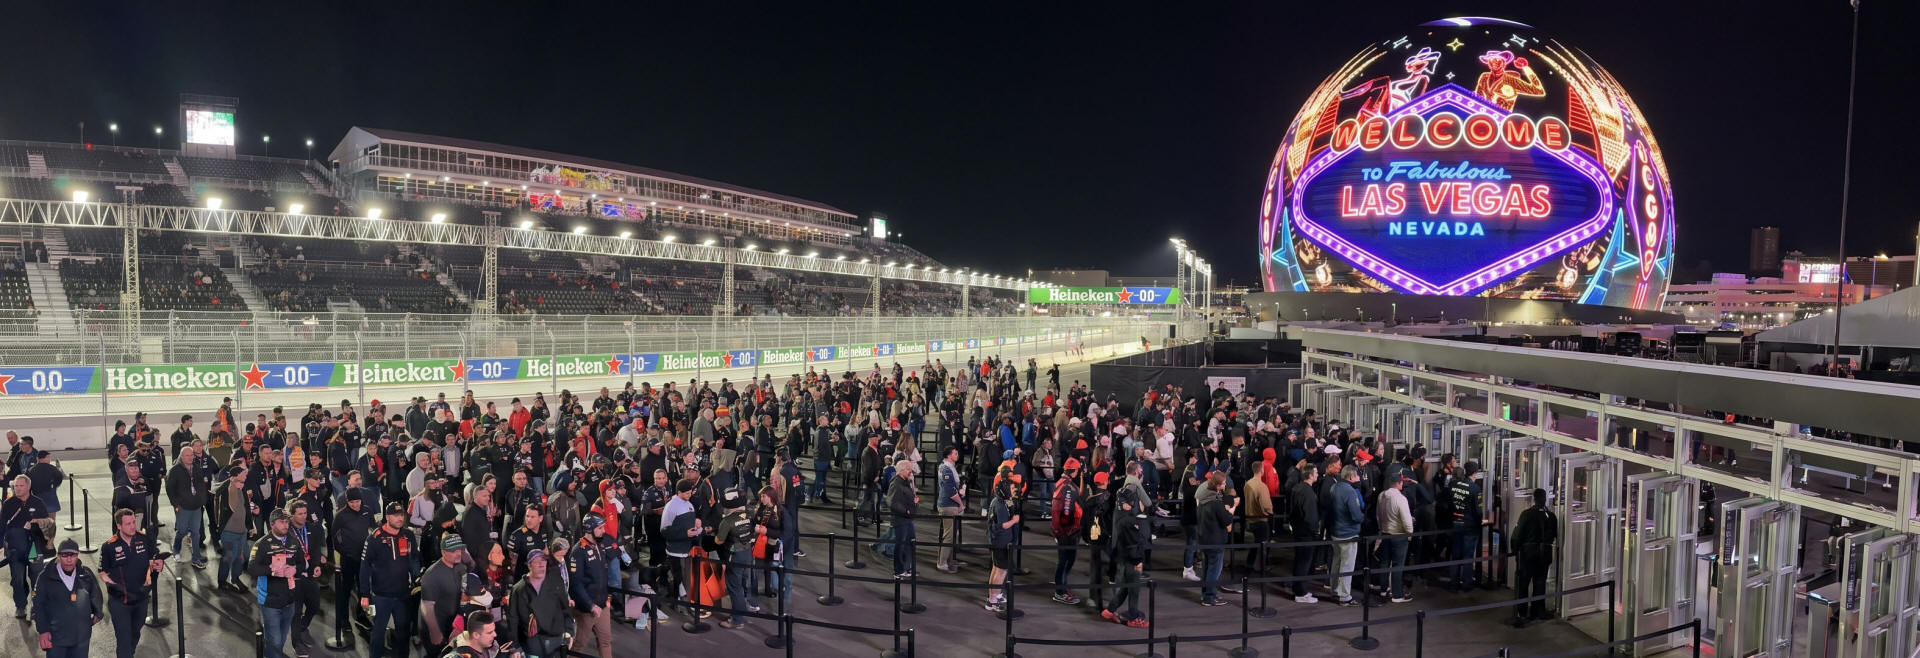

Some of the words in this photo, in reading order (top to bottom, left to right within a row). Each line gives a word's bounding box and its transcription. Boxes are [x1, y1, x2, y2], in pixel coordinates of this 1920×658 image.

[1335, 120, 1562, 148] WELCOME
[1362, 167, 1382, 180] TO
[1385, 161, 1512, 181] Fabulous
[1342, 183, 1406, 217] LAS
[1420, 182, 1551, 217] VEGAS
[1389, 222, 1484, 236] NEVADA
[1049, 288, 1113, 302] Heineken
[106, 367, 236, 390] Heineken
[344, 363, 445, 384] Heineken
[526, 358, 604, 377] Heineken
[663, 354, 720, 370] Heineken
[839, 346, 871, 357] Heneken
